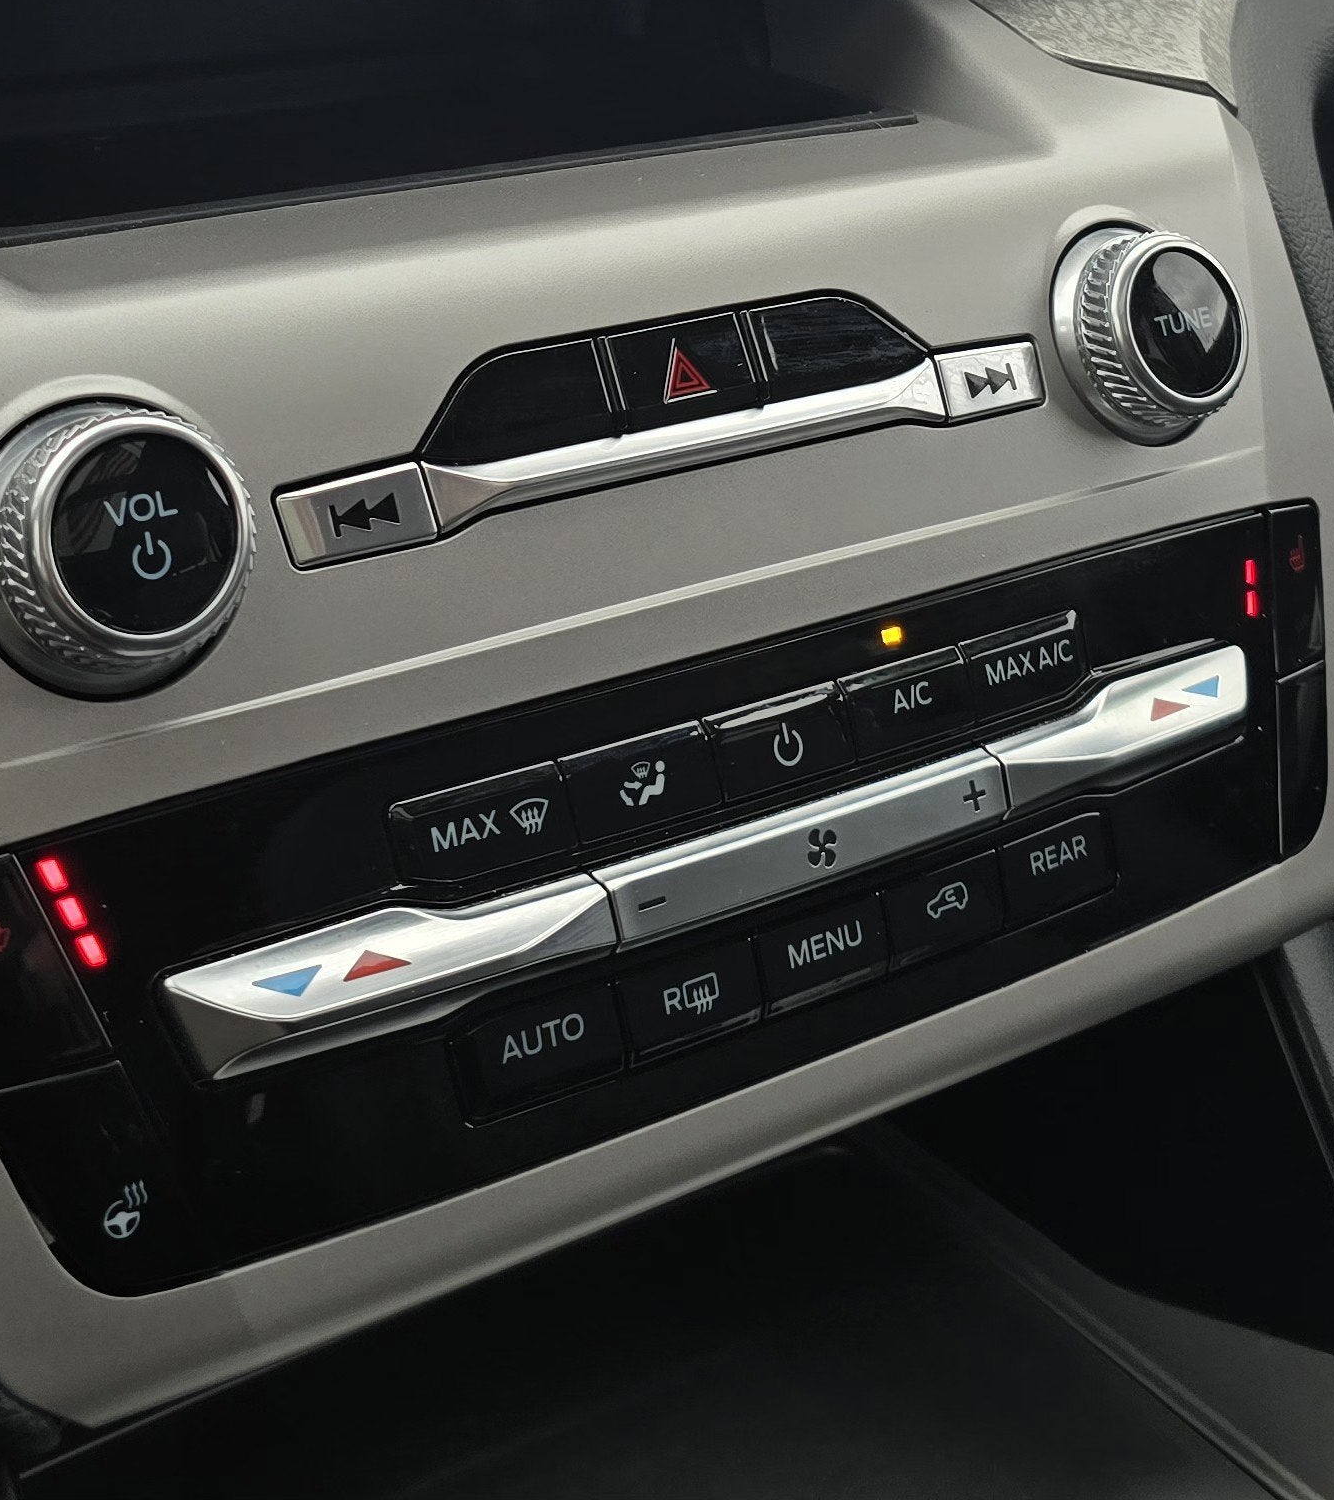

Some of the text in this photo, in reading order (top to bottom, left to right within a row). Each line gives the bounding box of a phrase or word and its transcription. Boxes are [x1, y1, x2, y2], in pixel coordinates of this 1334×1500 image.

[1153, 306, 1213, 337] TUNE
[103, 490, 178, 528] VOL
[984, 638, 1074, 687] MAX A/C
[892, 681, 933, 715] A/C
[430, 808, 501, 853] MAX
[1028, 835, 1088, 876] REAR
[787, 920, 863, 970] MENU
[500, 1013, 585, 1065] AUTO
